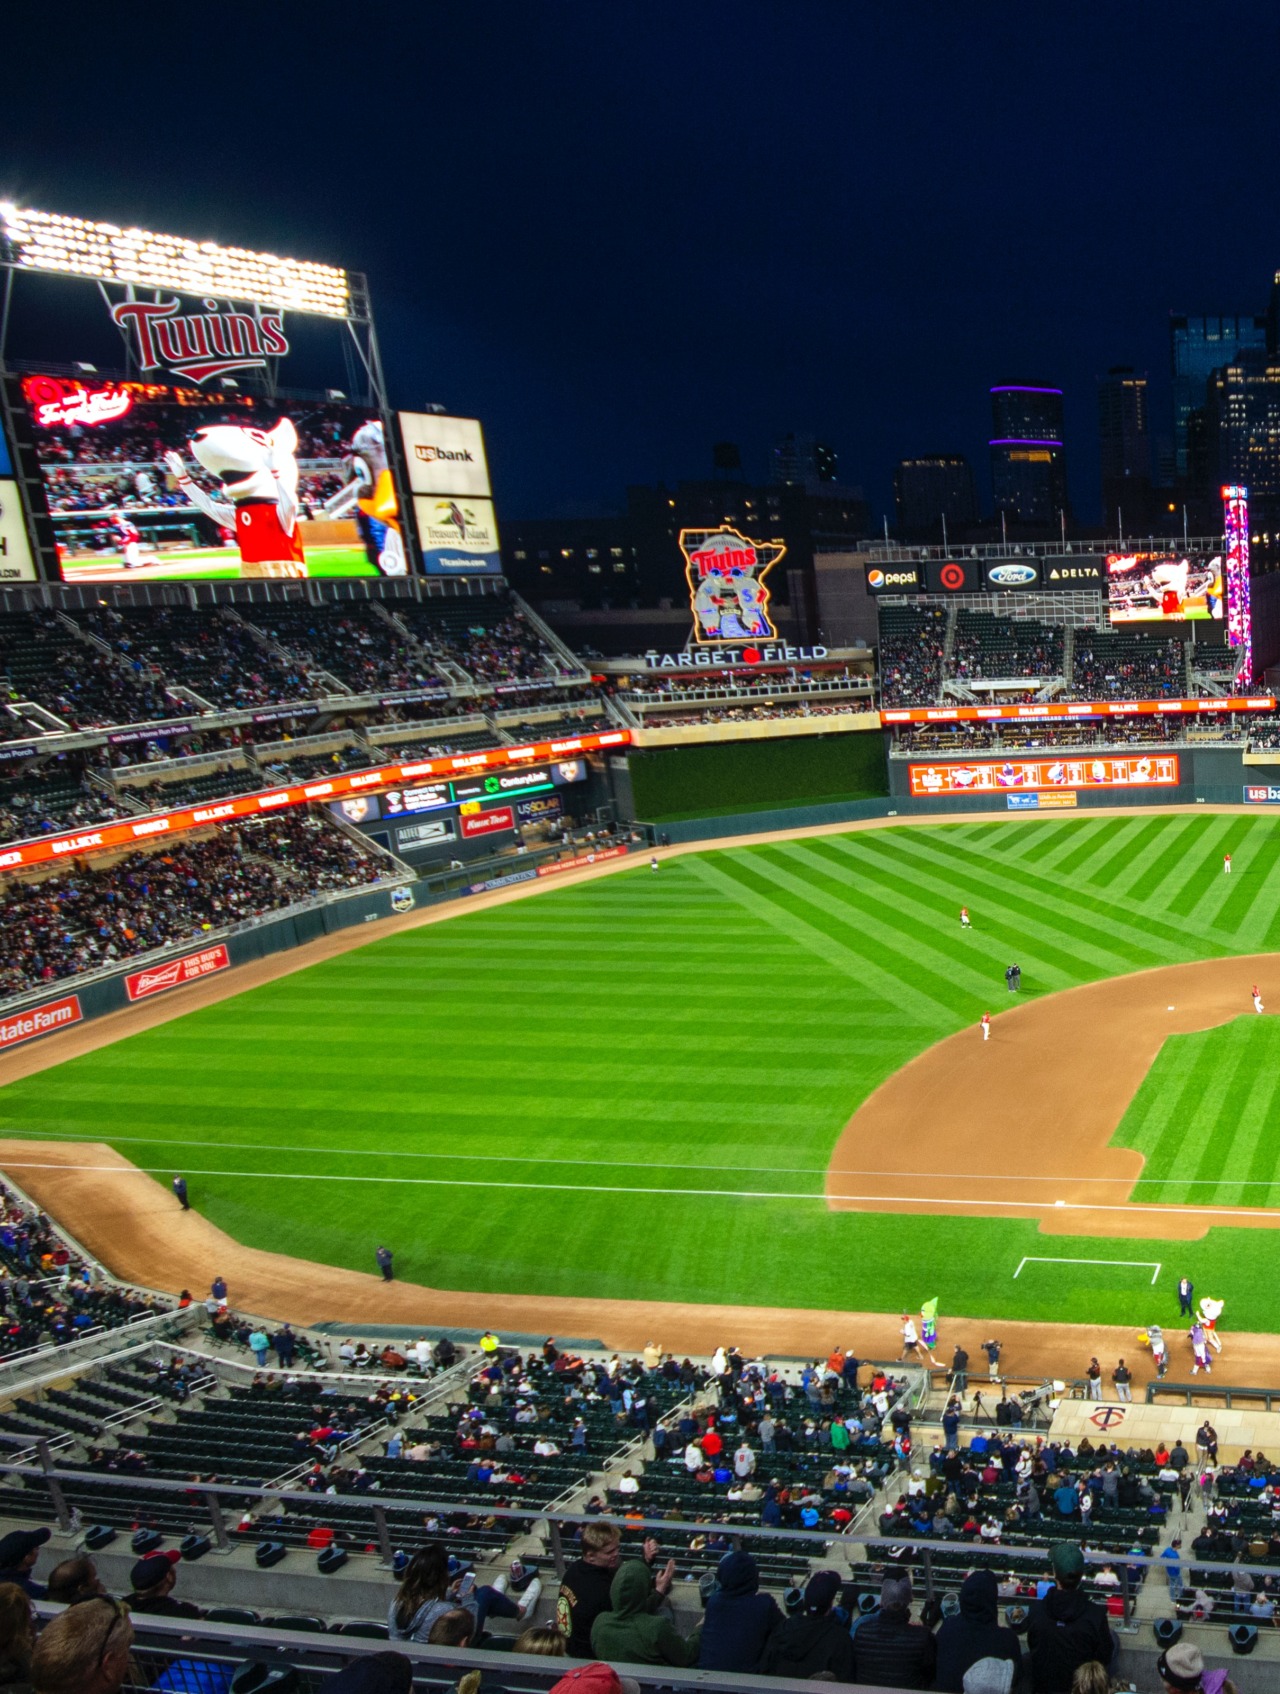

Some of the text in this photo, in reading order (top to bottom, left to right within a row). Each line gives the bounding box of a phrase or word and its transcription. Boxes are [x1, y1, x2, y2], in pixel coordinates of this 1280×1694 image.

[113, 296, 289, 383] Twins
[426, 526, 489, 539] Treasure Island
[690, 547, 757, 578] Twins
[885, 570, 917, 585] pepsi
[998, 568, 1027, 581] Ford
[1061, 568, 1099, 578] DELTA
[646, 646, 828, 668] TARGET FIELD
[139, 730, 158, 739] Home
[158, 728, 171, 736] Run
[171, 724, 189, 734] Porch
[12, 749, 33, 758] Porch
[500, 772, 548, 789] CenturyLink
[51, 833, 104, 854] BULLSEYE
[193, 804, 235, 822] BULLSEYE
[539, 864, 561, 875] GETTING
[561, 861, 577, 870] MORE
[183, 949, 222, 968] THIS BUD'S
[185, 967, 200, 978] FOR
[0, 1005, 72, 1043] tateFarm
